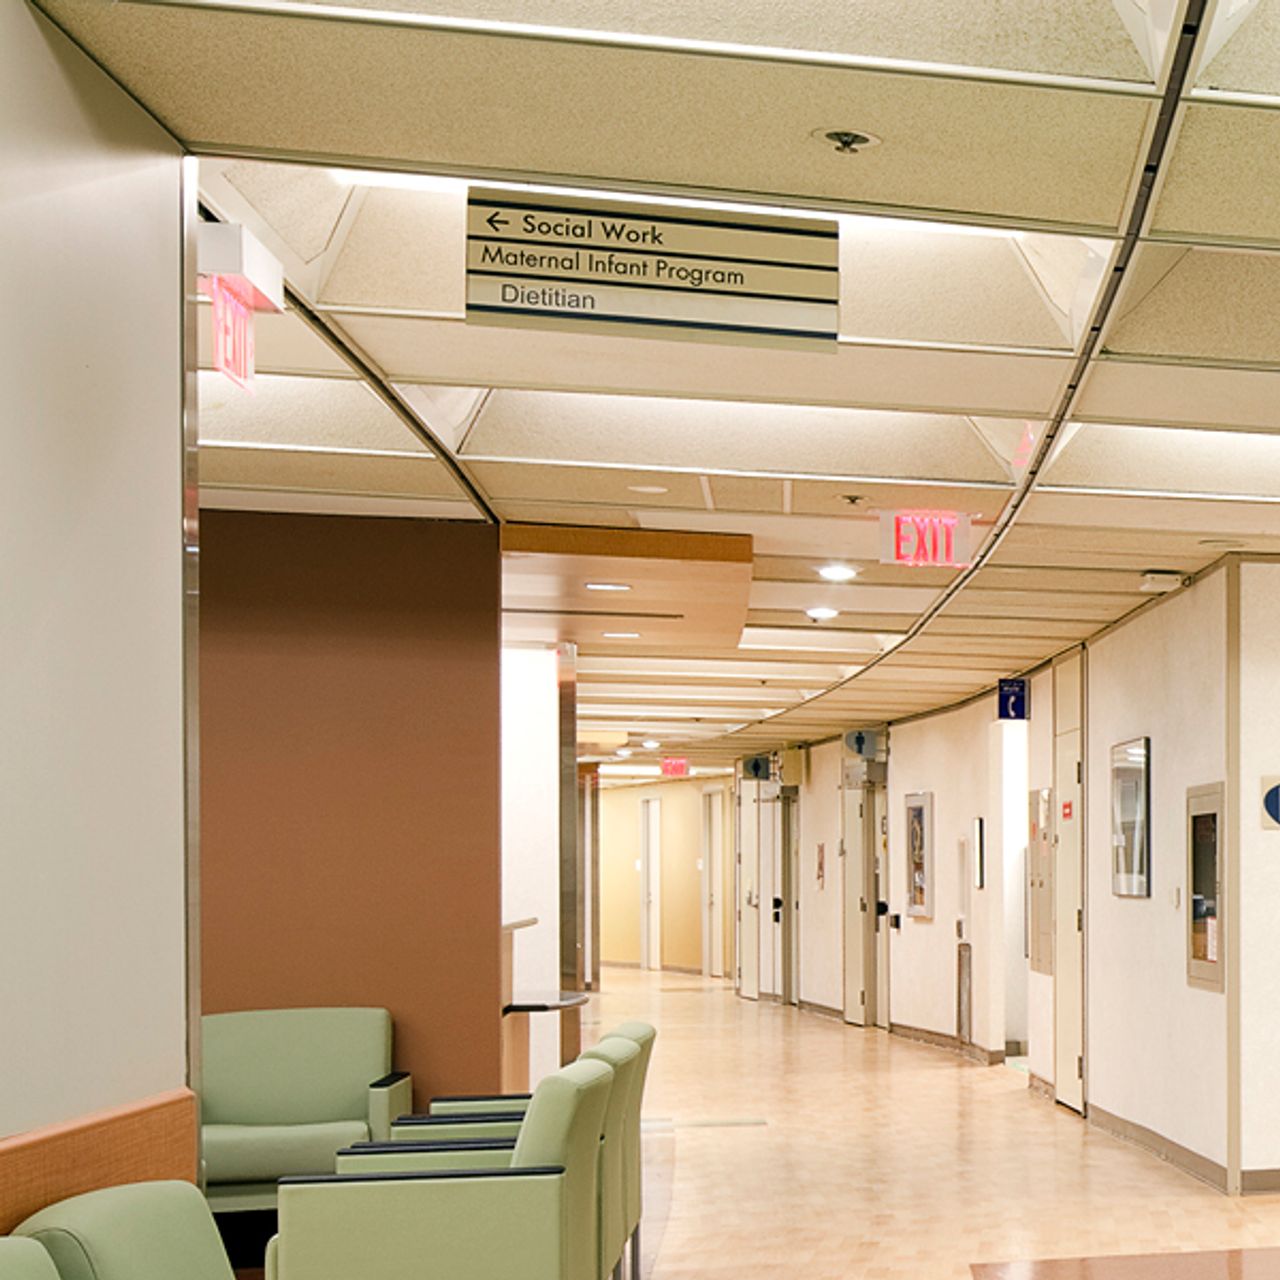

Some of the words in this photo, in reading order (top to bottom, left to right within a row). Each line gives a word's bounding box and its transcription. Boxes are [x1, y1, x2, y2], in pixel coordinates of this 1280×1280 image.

[522, 214, 593, 239] Social
[601, 221, 664, 245] Work
[480, 246, 580, 271] Maternal
[588, 253, 648, 277] Infant
[656, 261, 745, 287] Program
[501, 284, 595, 310] Dietitian
[894, 515, 959, 562] EXIT
